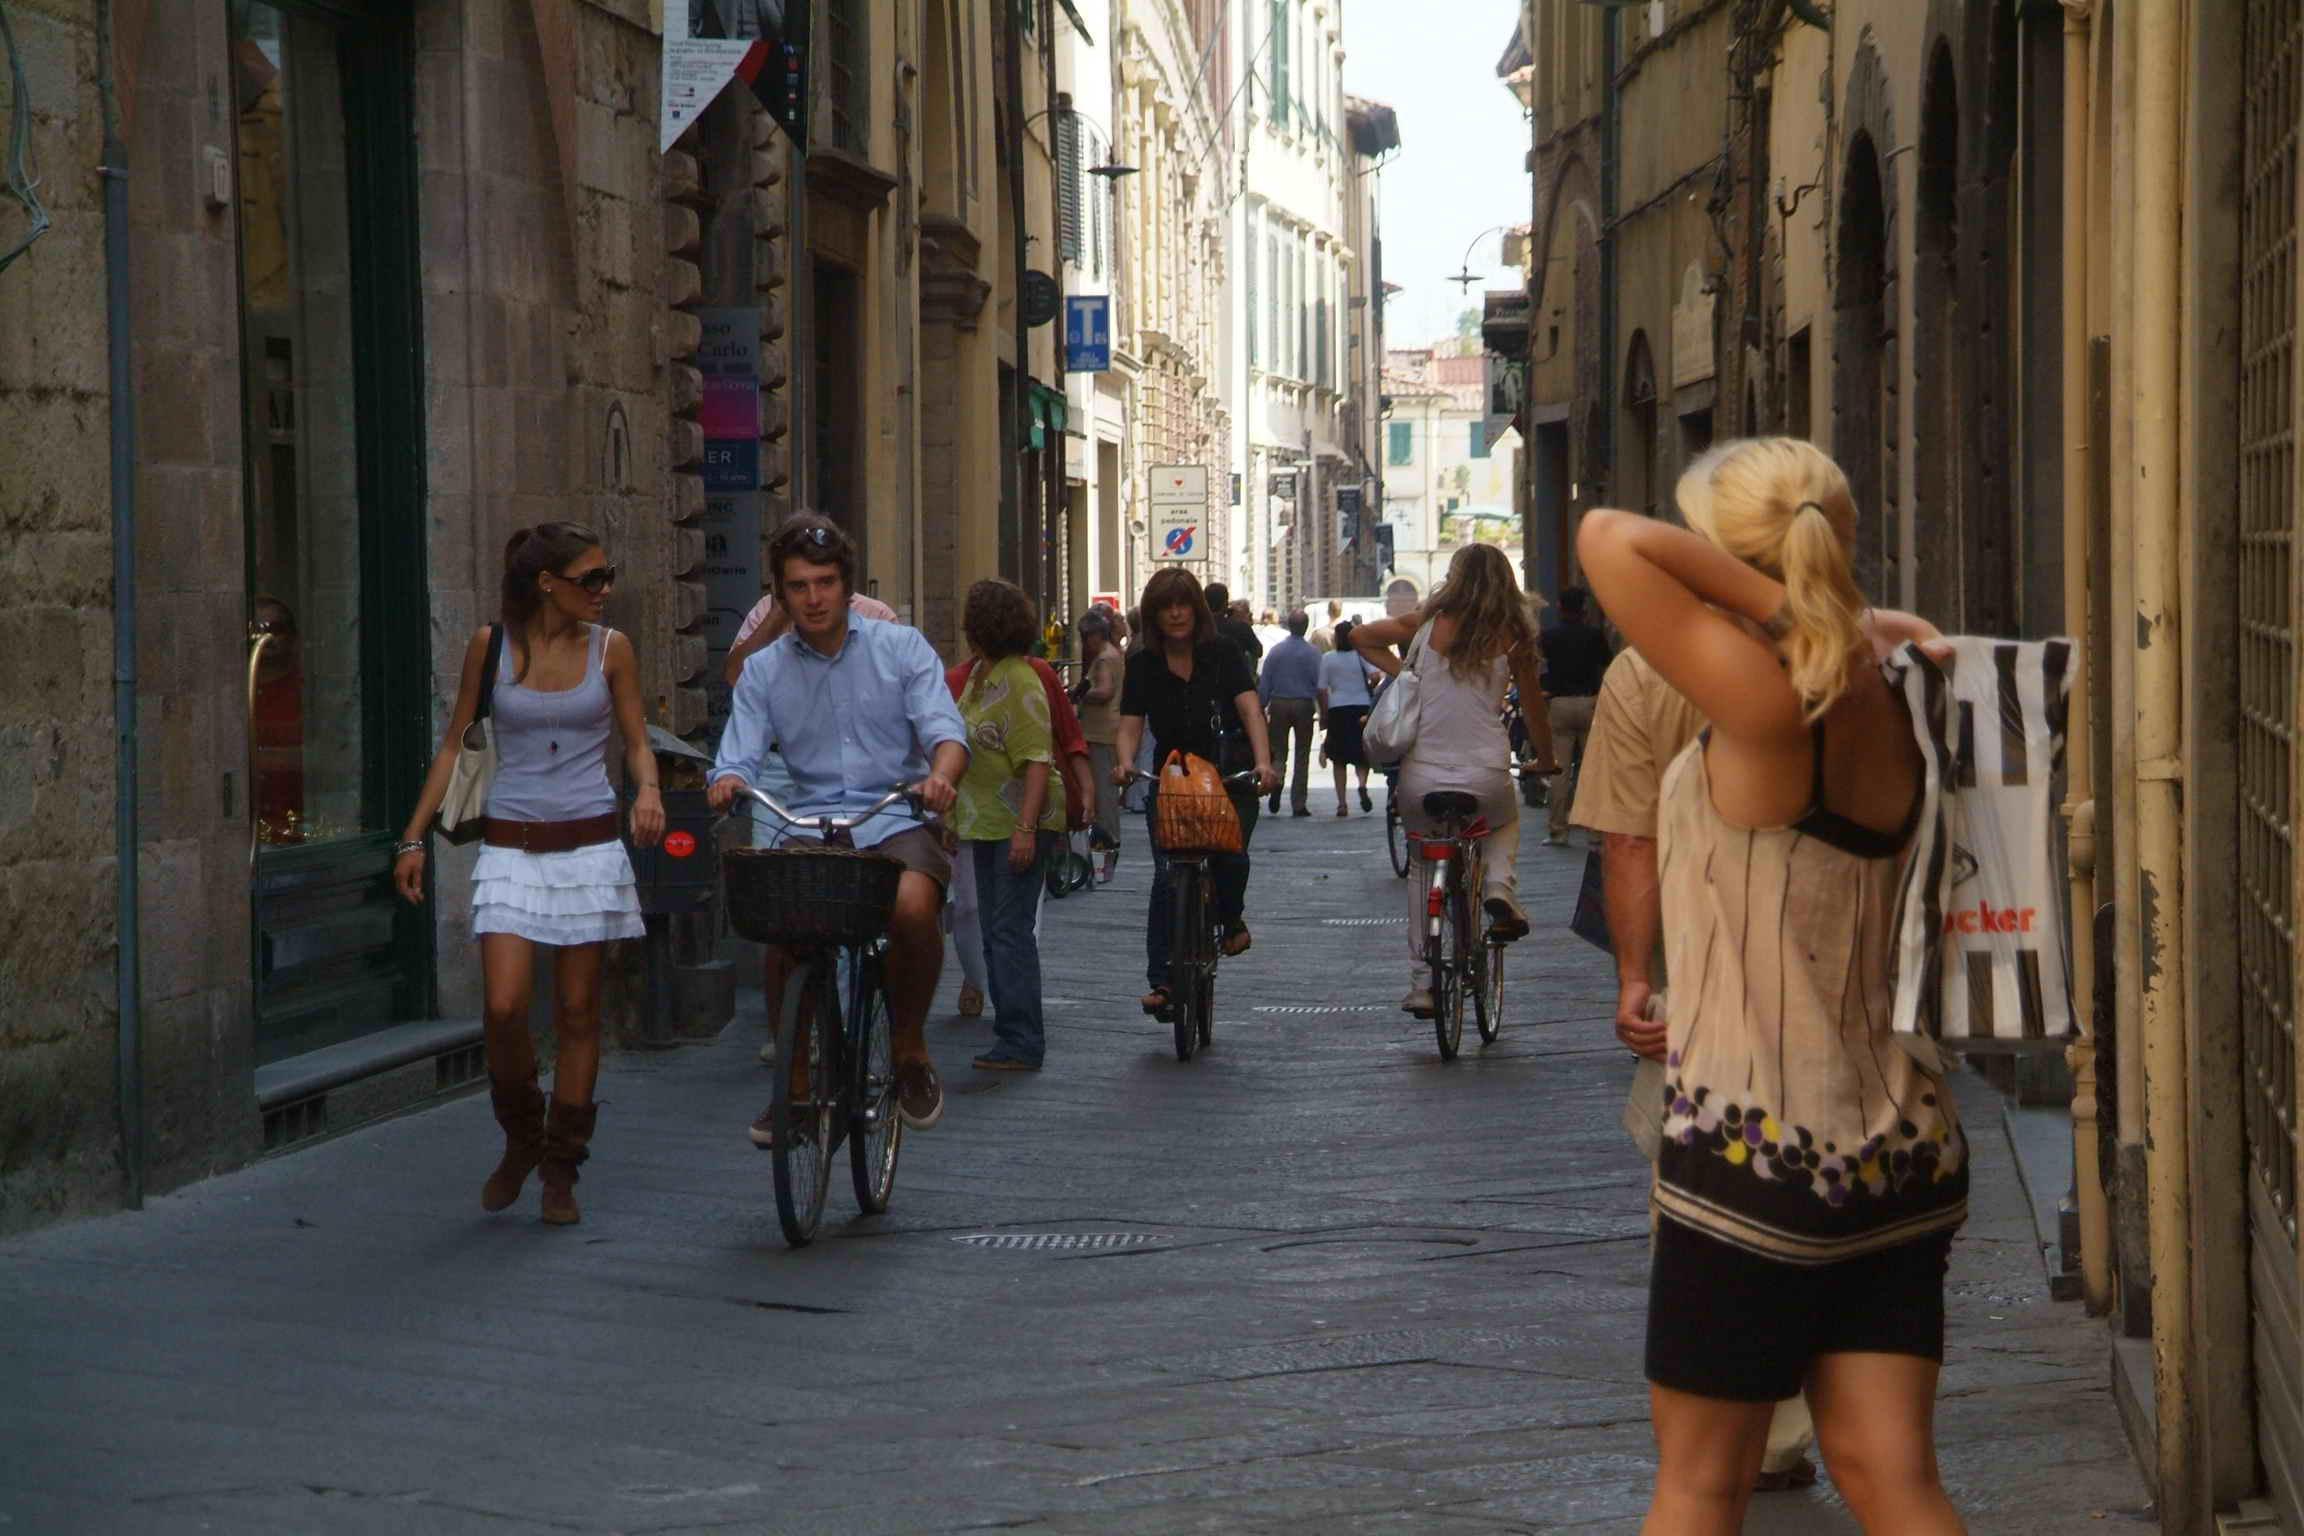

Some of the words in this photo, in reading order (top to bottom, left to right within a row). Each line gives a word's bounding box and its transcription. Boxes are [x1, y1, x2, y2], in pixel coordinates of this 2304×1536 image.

[1073, 300, 1104, 347] T
[708, 451, 732, 463] ER
[1161, 517, 1198, 525] pedonale
